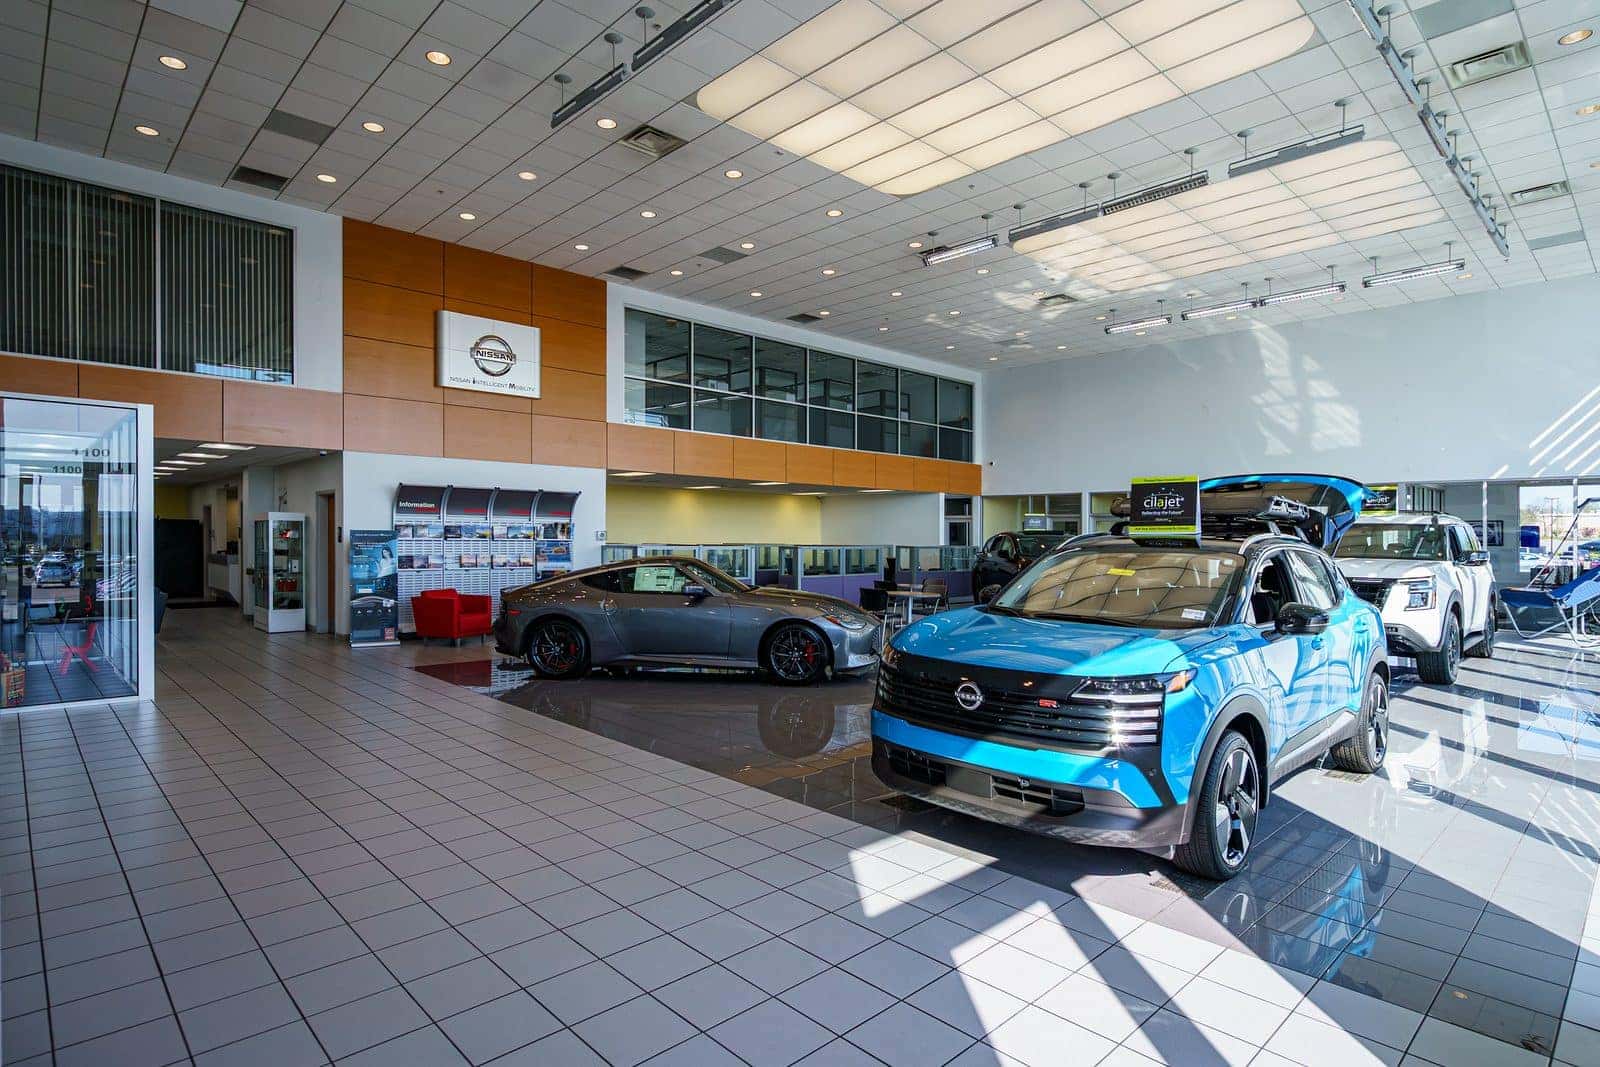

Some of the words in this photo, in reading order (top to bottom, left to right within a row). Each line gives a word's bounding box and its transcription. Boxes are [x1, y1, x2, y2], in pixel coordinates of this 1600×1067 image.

[475, 349, 513, 361] NISSAN
[449, 376, 470, 384] NISSAN
[399, 501, 435, 509] Information
[1143, 495, 1181, 510] cilajet
